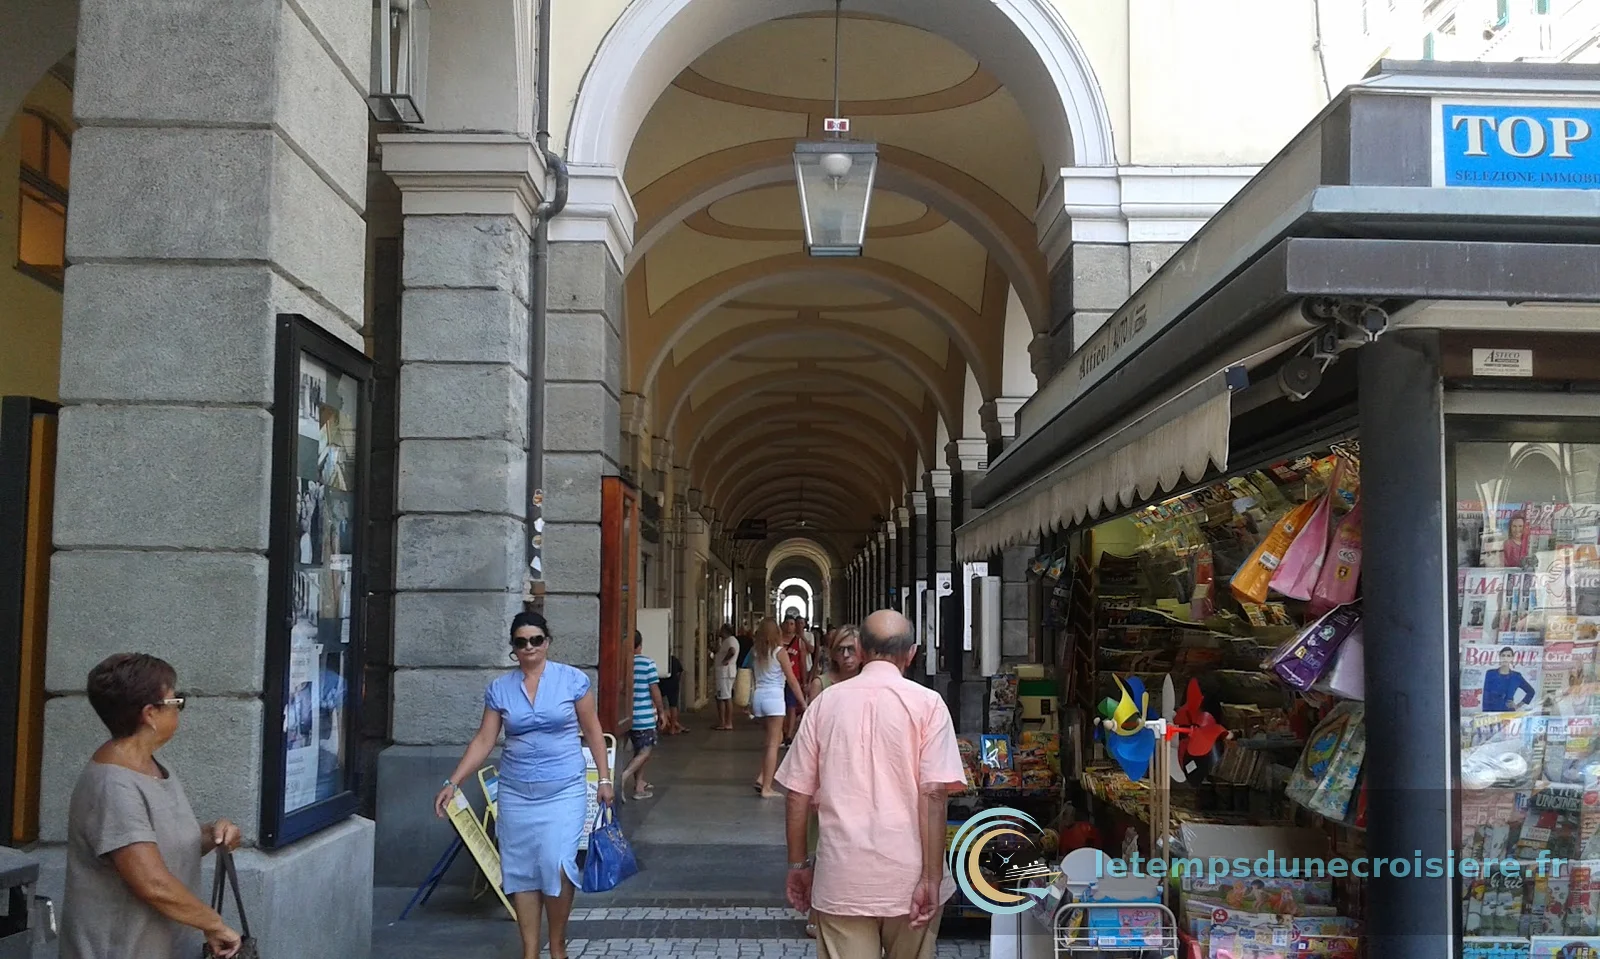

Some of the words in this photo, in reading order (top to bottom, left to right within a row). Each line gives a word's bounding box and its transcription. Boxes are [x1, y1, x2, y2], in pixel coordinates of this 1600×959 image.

[1452, 115, 1592, 160] TOP
[1455, 170, 1537, 183] SELEZIONE
[1465, 646, 1539, 667] BOUQUE
